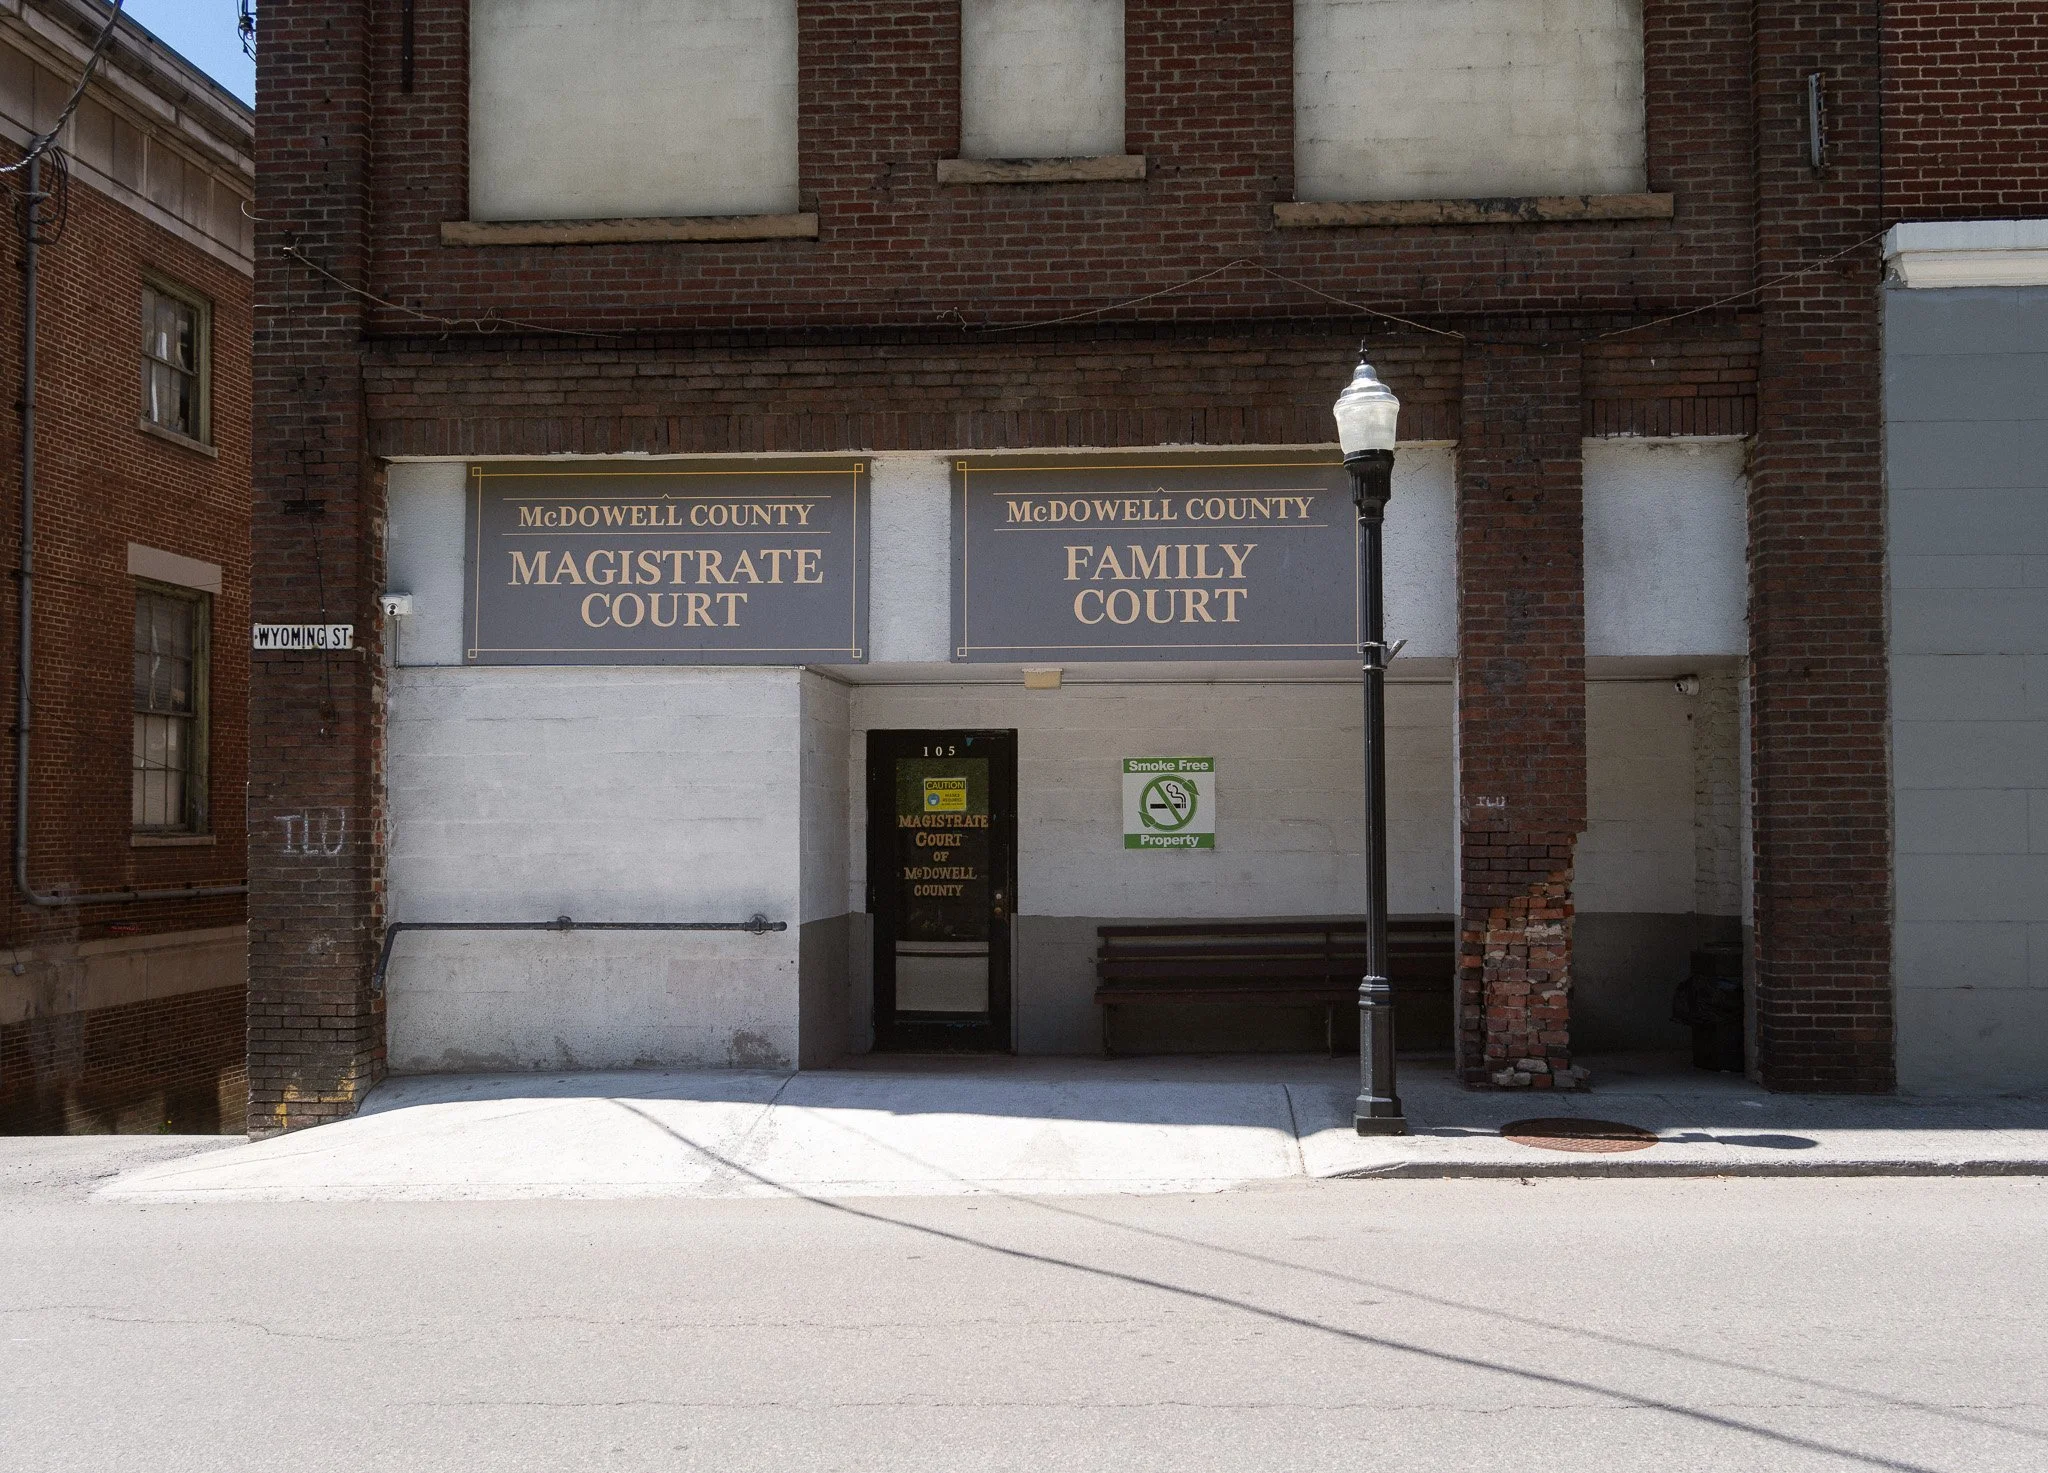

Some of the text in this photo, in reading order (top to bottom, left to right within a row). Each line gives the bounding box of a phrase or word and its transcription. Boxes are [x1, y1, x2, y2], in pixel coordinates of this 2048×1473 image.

[518, 503, 815, 528] McDOWELL COUNTY
[1006, 496, 1315, 524] McDOWELL COUNTY
[507, 548, 824, 587] MAGISTRATE
[1063, 543, 1258, 581] FAMILY
[580, 591, 748, 629] COURT
[1073, 588, 1248, 626] COURT
[258, 627, 349, 646] WYOMING ST
[923, 746, 955, 757] 105
[1128, 760, 1209, 771] Smoke Free
[926, 781, 964, 790] CAUTION
[899, 814, 989, 828] MAGISTRATE
[1140, 834, 1200, 848] Property
[933, 851, 949, 862] OF
[904, 867, 977, 880] McDOWELL
[914, 885, 964, 897] COUNTY
